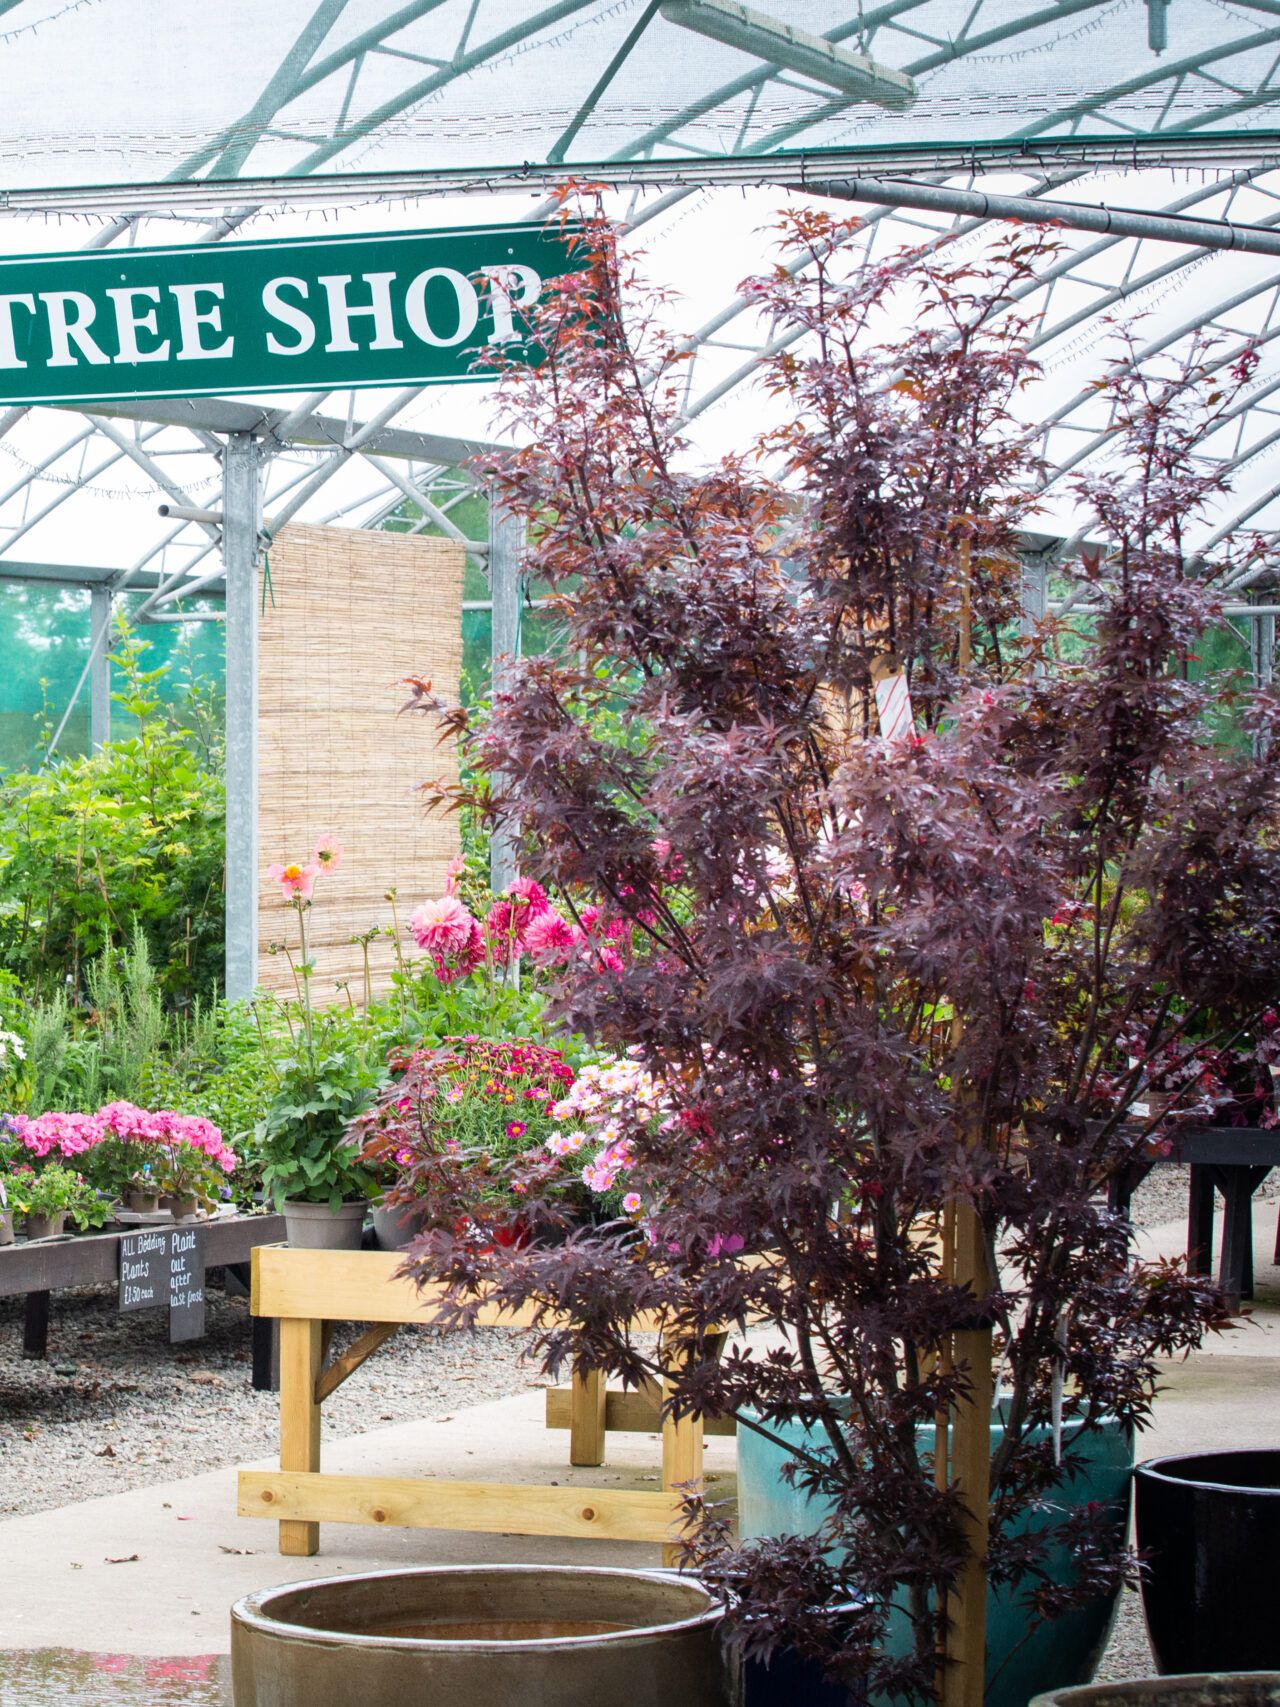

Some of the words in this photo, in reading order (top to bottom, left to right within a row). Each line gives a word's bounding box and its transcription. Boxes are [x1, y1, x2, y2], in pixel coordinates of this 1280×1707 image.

[263, 264, 542, 356] SHOP
[122, 1239, 135, 1257] ALL
[137, 1233, 166, 1255] Bedding
[171, 1231, 196, 1254] Plant
[122, 1260, 149, 1281] Plants
[171, 1256, 186, 1272] out
[141, 1286, 154, 1299] each
[170, 1272, 192, 1293] after
[170, 1291, 186, 1307] last
[187, 1288, 204, 1308] frost
